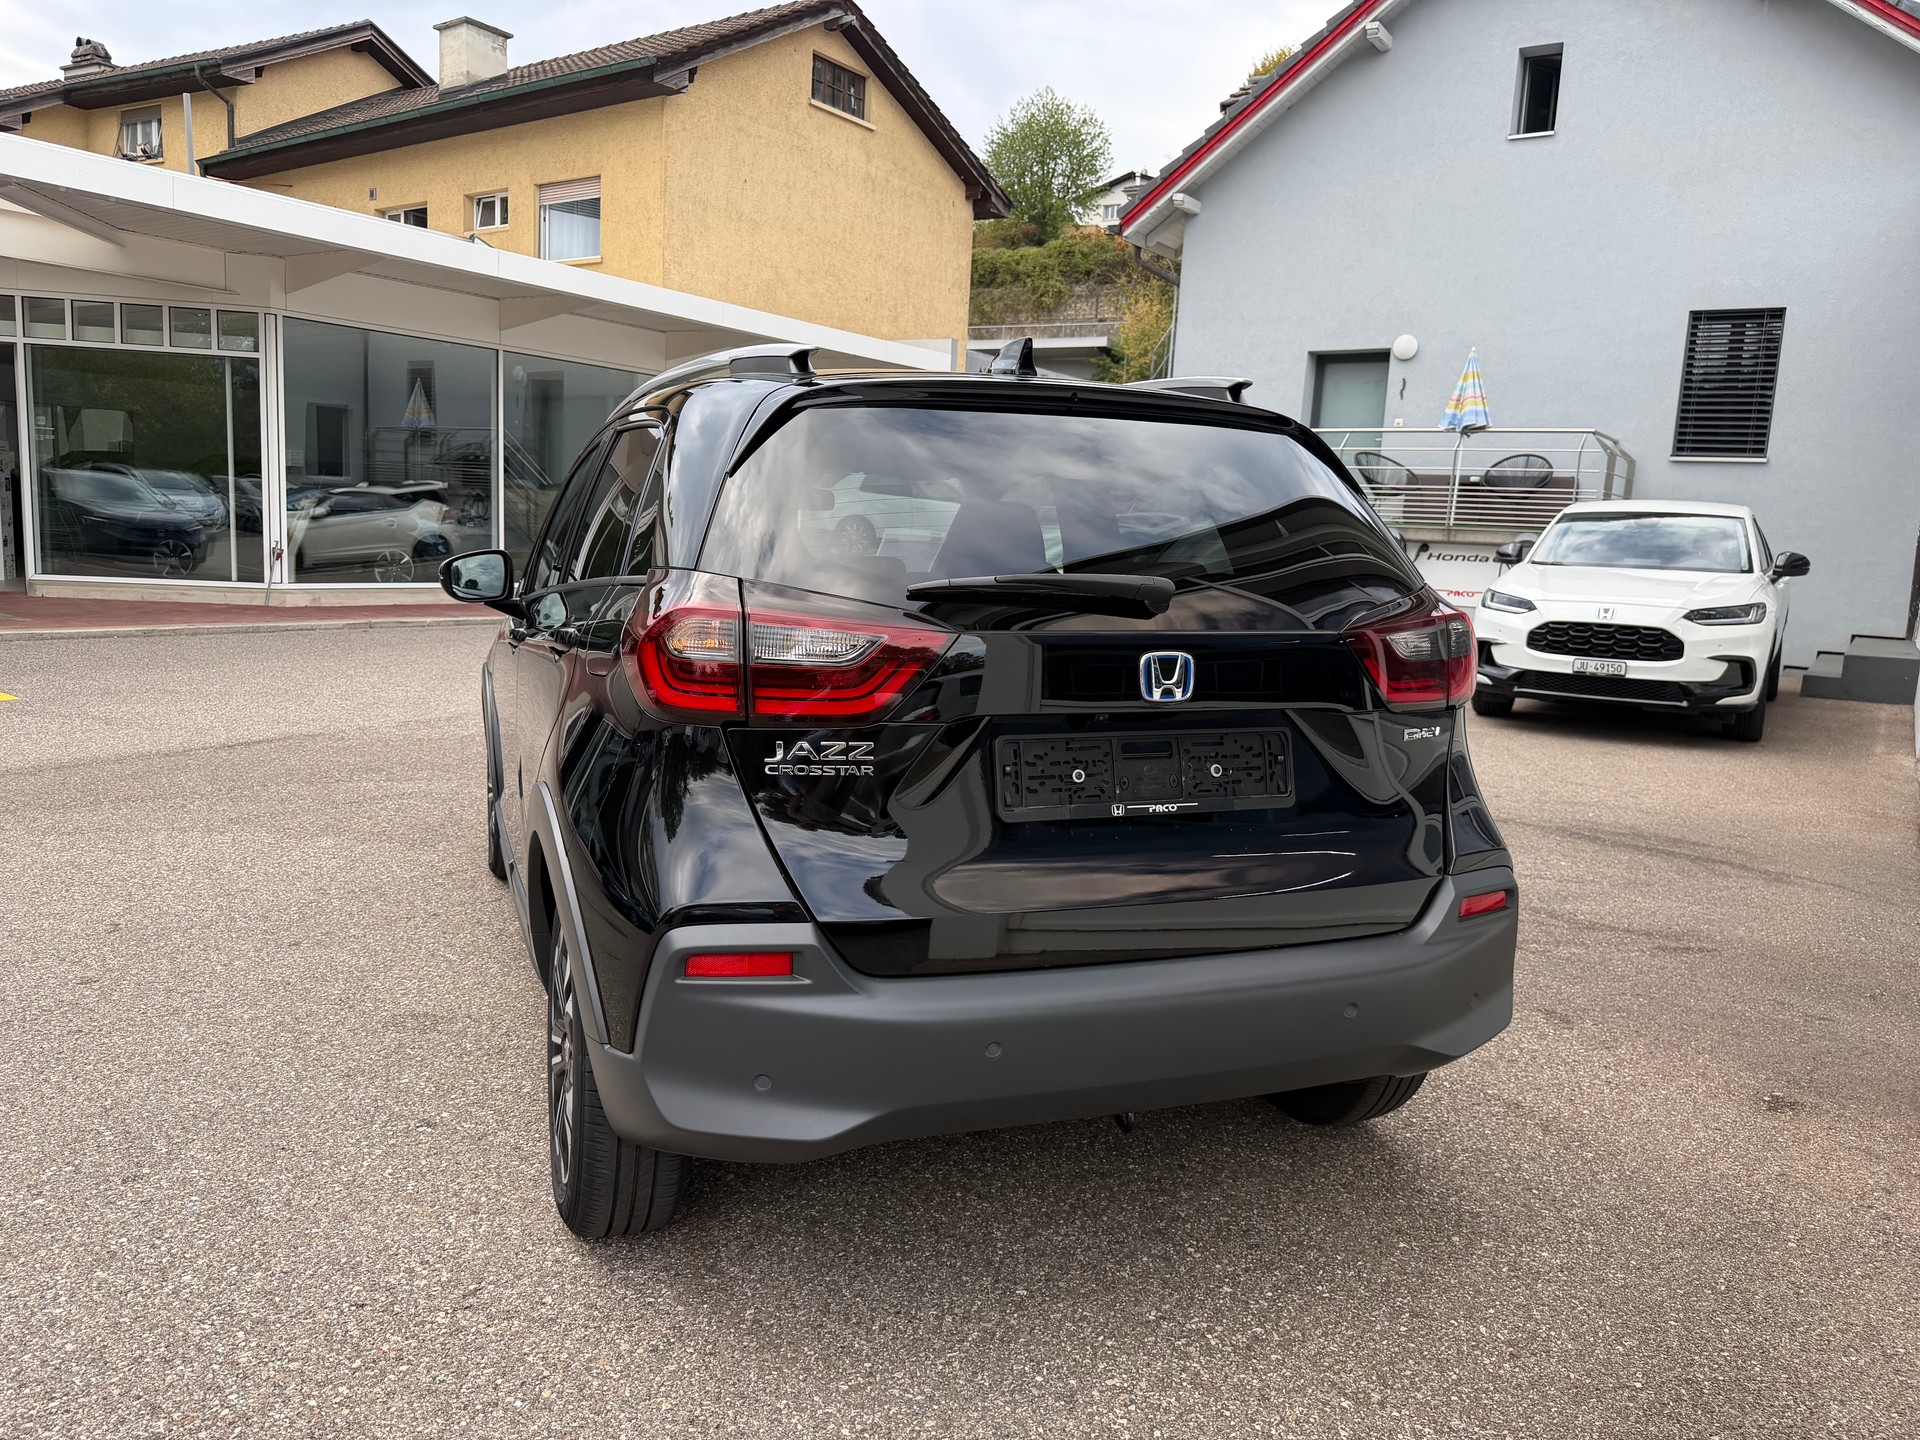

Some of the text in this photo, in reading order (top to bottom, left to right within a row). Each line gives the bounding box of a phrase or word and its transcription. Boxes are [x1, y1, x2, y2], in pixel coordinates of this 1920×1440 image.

[1427, 552, 1490, 563] Honda
[764, 741, 874, 762] JAZZ
[764, 764, 874, 776] CROSSTAR
[1148, 804, 1178, 813] PACO
